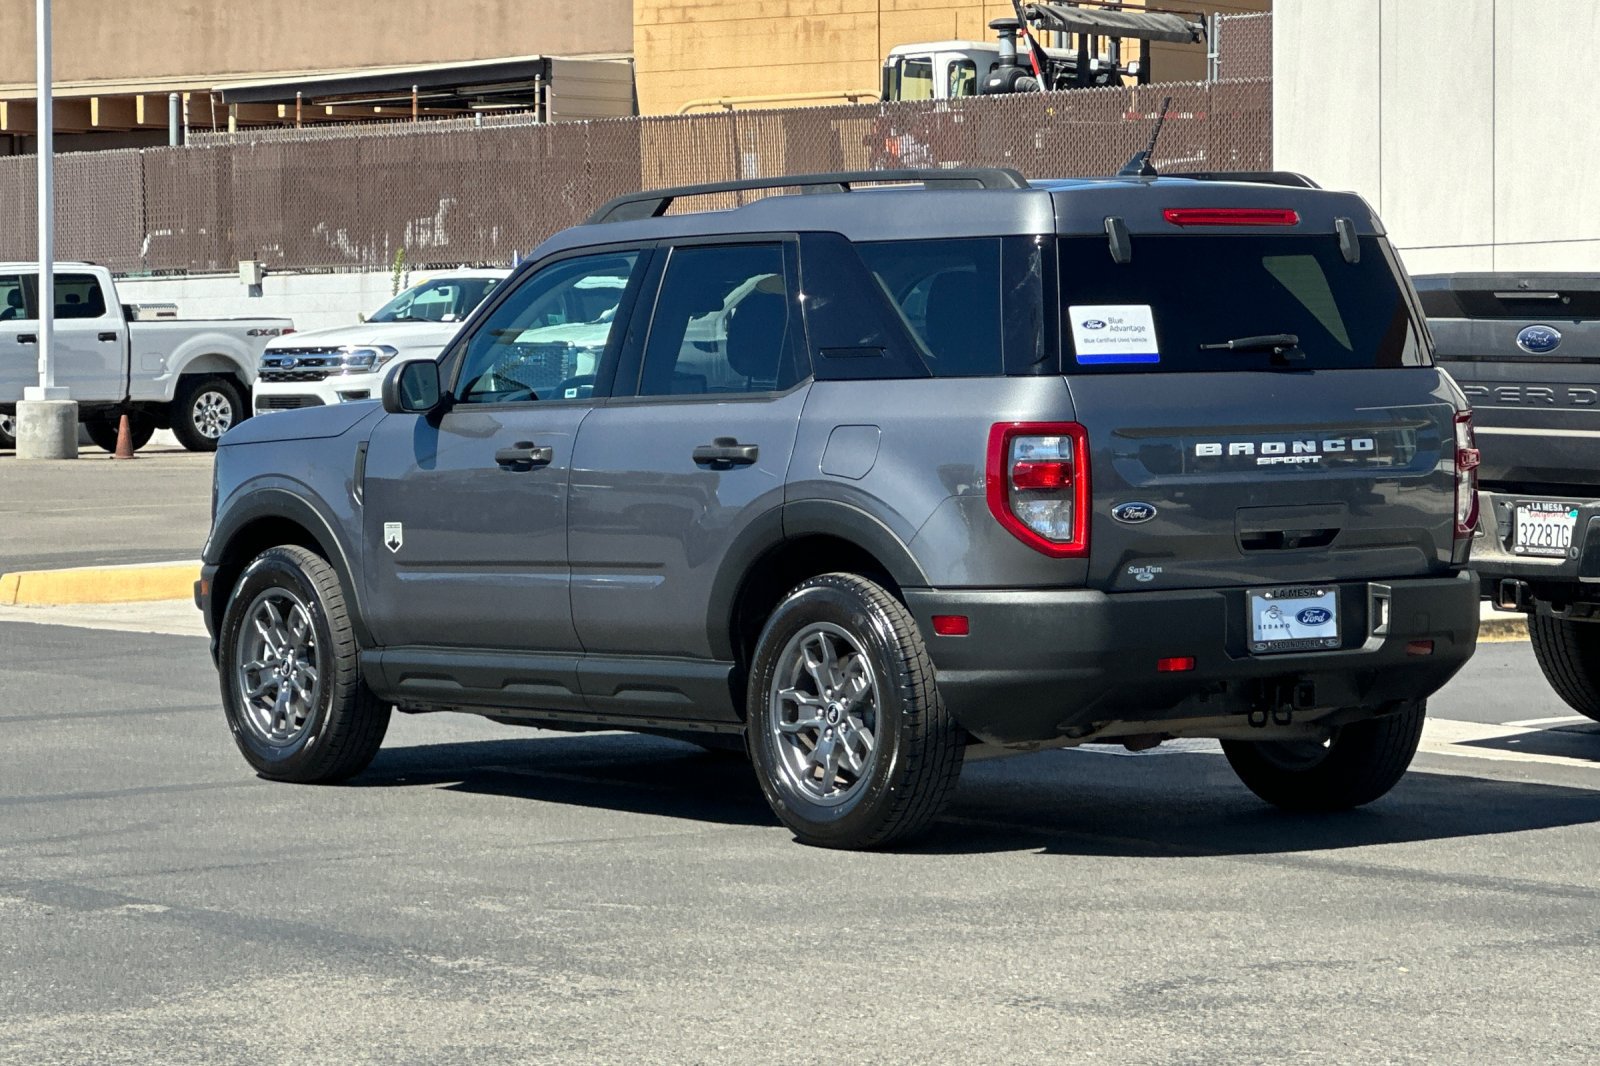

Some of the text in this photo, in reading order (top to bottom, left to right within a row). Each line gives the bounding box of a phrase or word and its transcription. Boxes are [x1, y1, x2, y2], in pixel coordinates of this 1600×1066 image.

[1109, 325, 1146, 333] Advantage
[1195, 438, 1374, 457] BRONCO
[1256, 455, 1323, 466] SPORT
[1123, 506, 1148, 519] Ford
[1531, 502, 1542, 511] LA
[1542, 502, 1564, 512] MESA
[1520, 522, 1569, 548] 32287G
[1273, 588, 1316, 599] LA MESA
[1302, 609, 1325, 623] Ford
